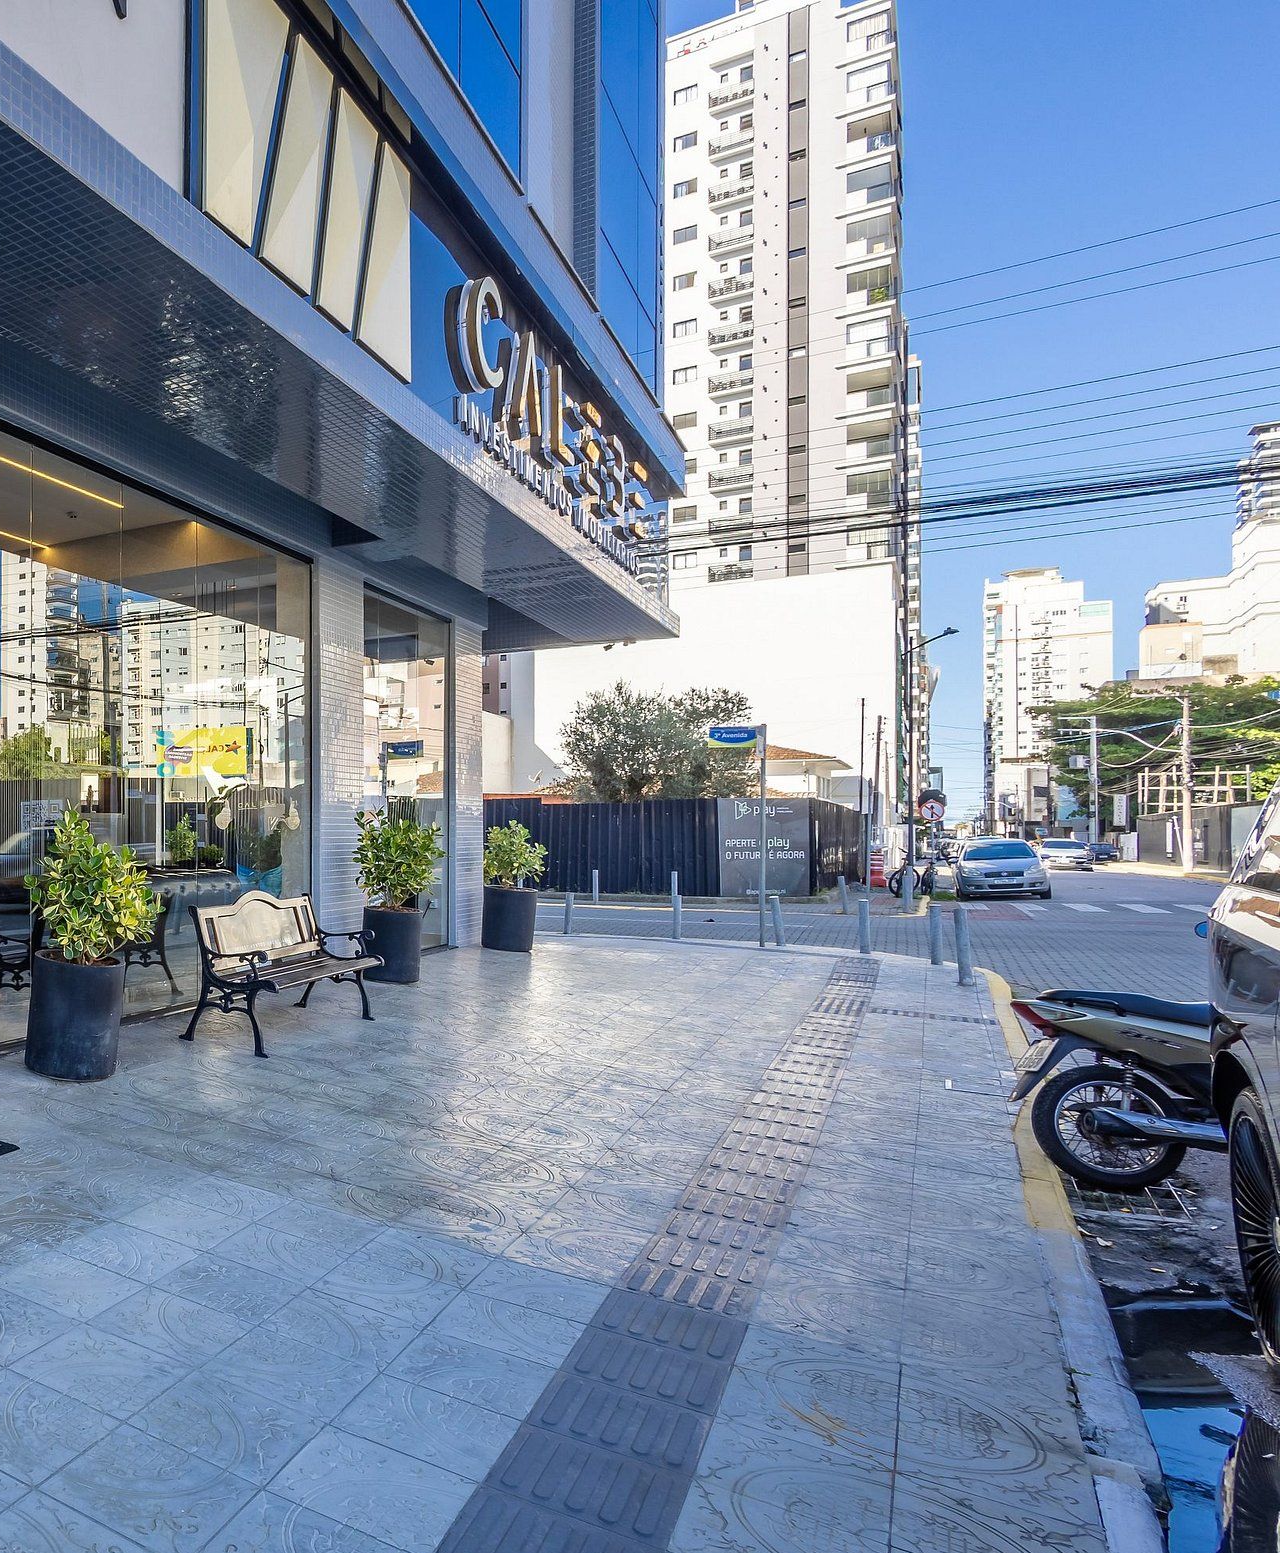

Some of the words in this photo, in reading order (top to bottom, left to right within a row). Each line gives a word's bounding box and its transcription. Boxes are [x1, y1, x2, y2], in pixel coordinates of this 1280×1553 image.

[460, 394, 573, 517] INVESTIMENTOS
[753, 805, 775, 817] pay
[725, 839, 757, 847] APERTE
[767, 836, 790, 850] play
[725, 851, 732, 859] O
[734, 851, 763, 859] FUTUR
[768, 849, 775, 859] É
[776, 850, 805, 859] AGORA
